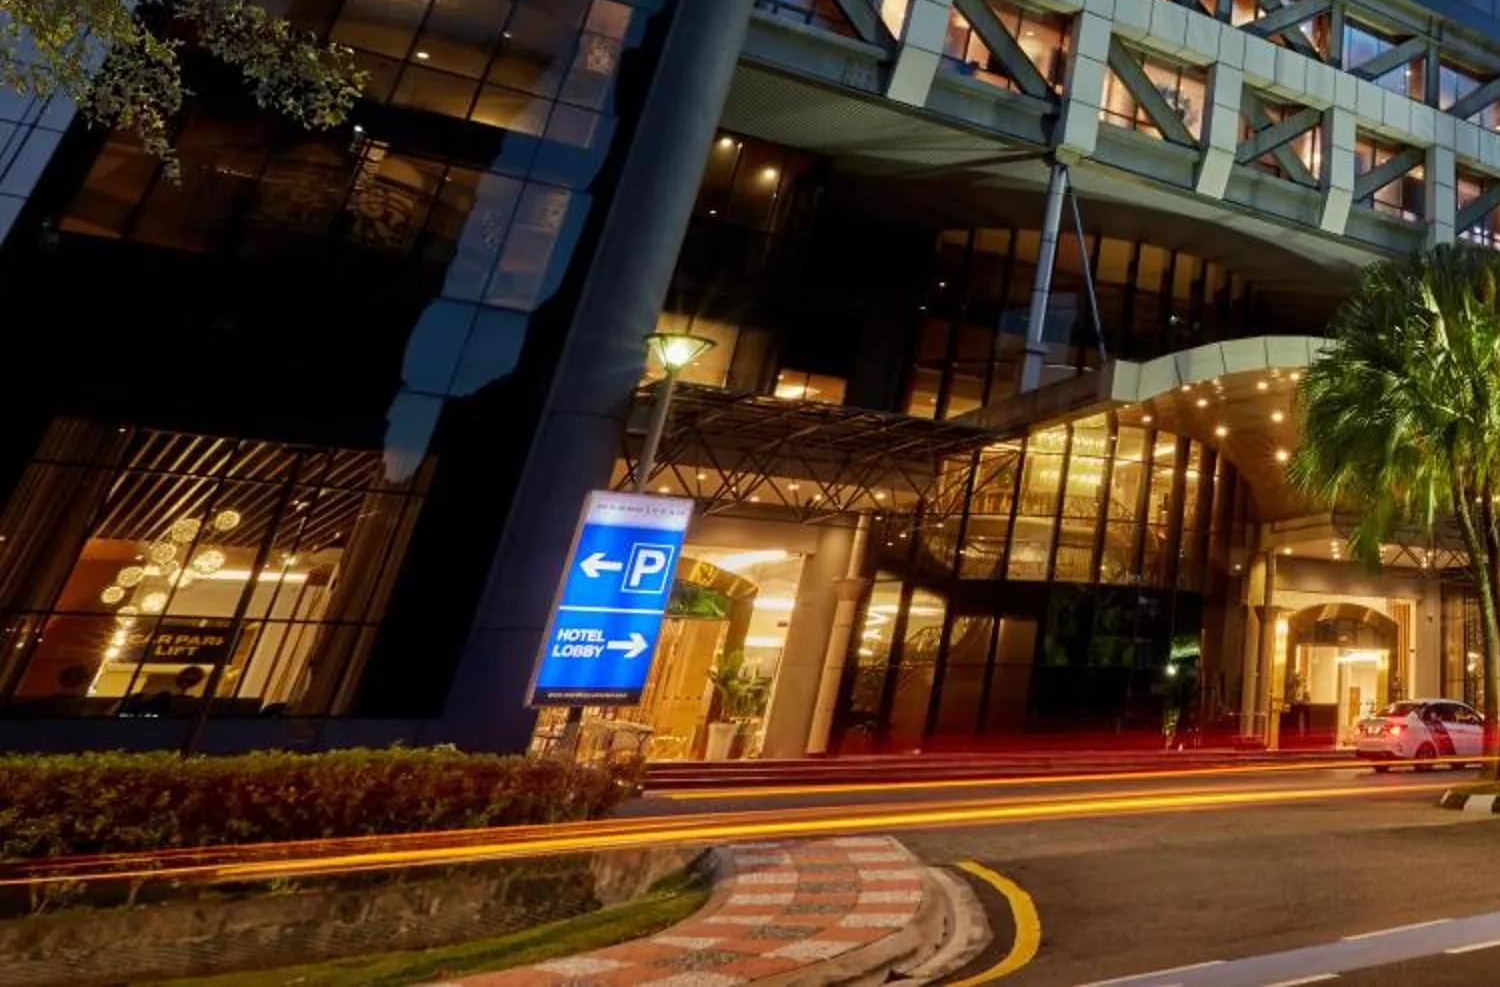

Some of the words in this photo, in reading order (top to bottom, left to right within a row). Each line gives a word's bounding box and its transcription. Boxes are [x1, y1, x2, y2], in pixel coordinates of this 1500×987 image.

[629, 548, 667, 588] P
[557, 628, 605, 642] HOTEL
[155, 646, 197, 656] LIFT
[552, 643, 605, 659] LOBBY
